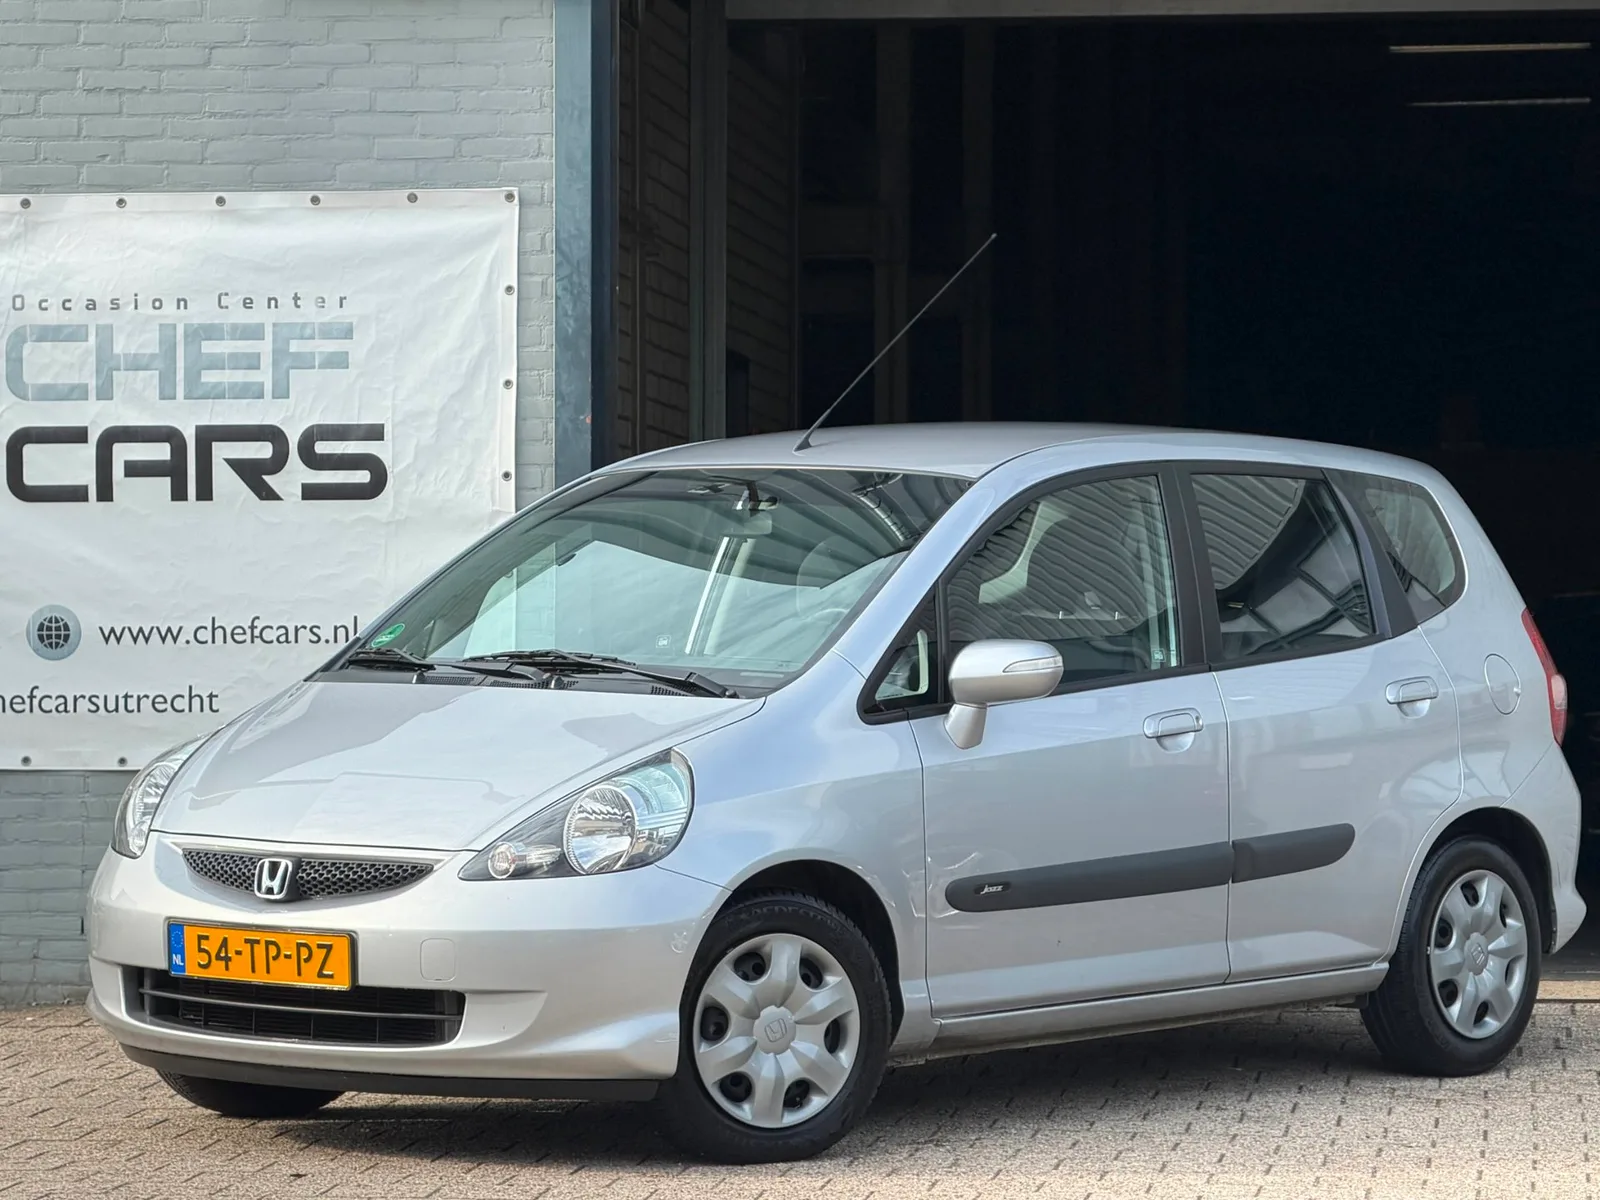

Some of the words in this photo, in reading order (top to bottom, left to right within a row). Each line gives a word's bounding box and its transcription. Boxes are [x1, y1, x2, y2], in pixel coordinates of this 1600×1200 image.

[12, 293, 189, 311] Occasion
[217, 292, 348, 310] Center
[6, 322, 354, 402] CHEF
[6, 423, 388, 503] CARS
[98, 615, 358, 645] www.chefcars.nl
[172, 953, 185, 966] NL
[196, 933, 335, 980] 54-TP-PZ
